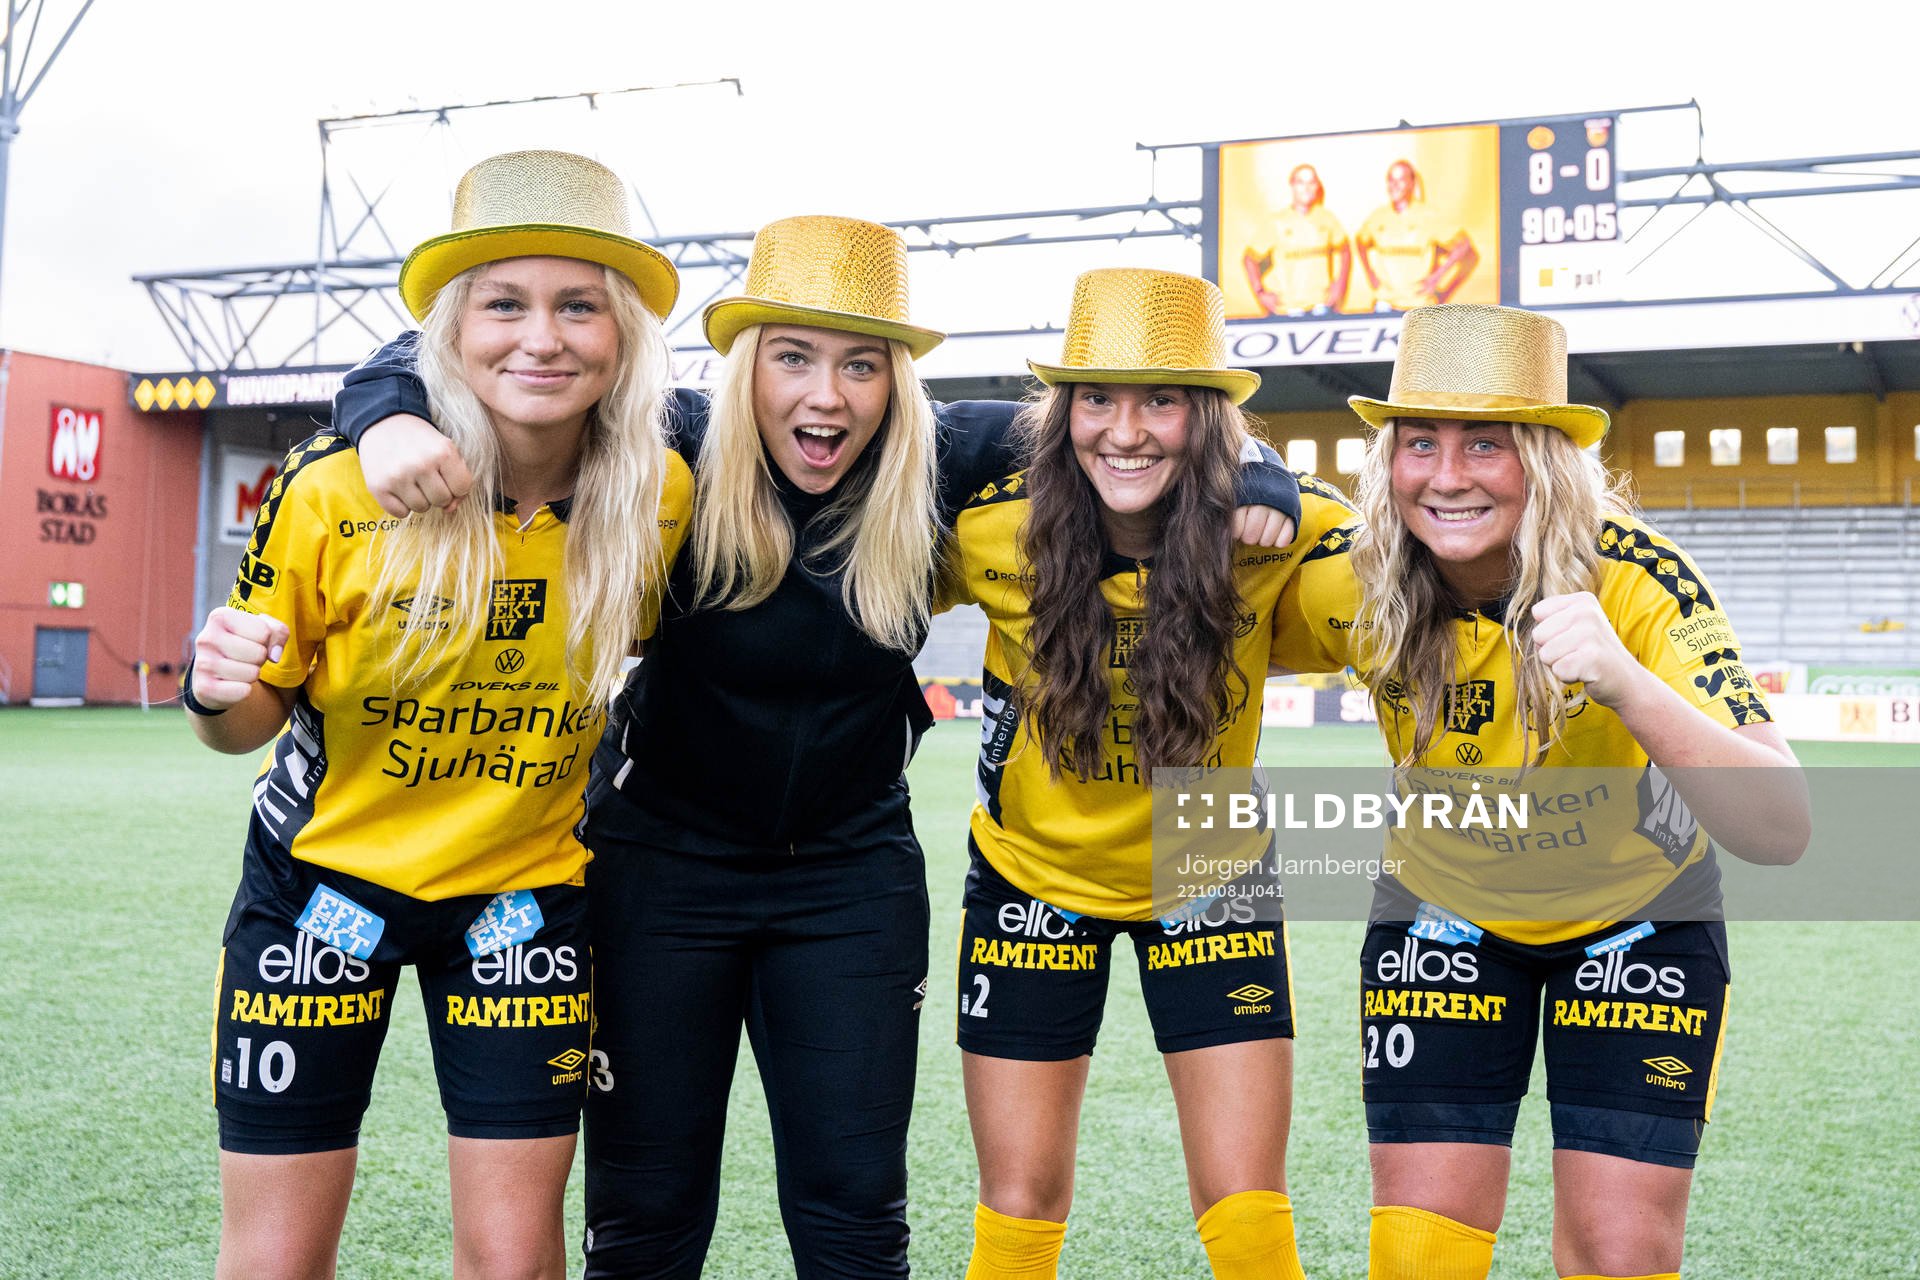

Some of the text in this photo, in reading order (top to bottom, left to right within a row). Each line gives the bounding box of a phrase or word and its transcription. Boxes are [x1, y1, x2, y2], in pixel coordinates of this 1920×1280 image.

[1528, 152, 1553, 194] 8
[1585, 148, 1610, 190] 0
[1230, 328, 1399, 359] OVEK
[37, 488, 107, 520] BORÅS
[41, 519, 96, 545] STAD
[1240, 552, 1293, 567] GRUPPEN
[493, 601, 541, 621] EKT
[494, 583, 537, 601] EFF
[490, 619, 518, 637] IV
[1115, 634, 1144, 650] EK
[450, 681, 560, 692] TOVEKS BIL
[361, 697, 597, 738] Sparbanke
[382, 739, 580, 788] Sjuhärad
[311, 892, 374, 933] EFF
[470, 903, 533, 953] EKT
[998, 900, 1087, 939] ello
[302, 912, 371, 955] EKT
[1148, 931, 1275, 970] RAMIRENT
[258, 930, 370, 985] ellos
[472, 943, 578, 985] ellos
[970, 937, 1098, 970] RAMIRENT
[1377, 937, 1479, 983] ellos
[1575, 950, 1686, 998] ellos
[231, 989, 385, 1027] RAMIRENT
[446, 992, 590, 1028] RAMIRENT
[969, 974, 991, 1018] 2
[1234, 1003, 1271, 1015] umbro
[1365, 989, 1507, 1021] RAMIRENT
[1553, 1000, 1707, 1036] RAMIRENT
[237, 1036, 296, 1093] 10
[1366, 1023, 1415, 1068] 20
[552, 1070, 583, 1085] umbro
[589, 1049, 614, 1092] 3
[1646, 1073, 1687, 1091] umbro
